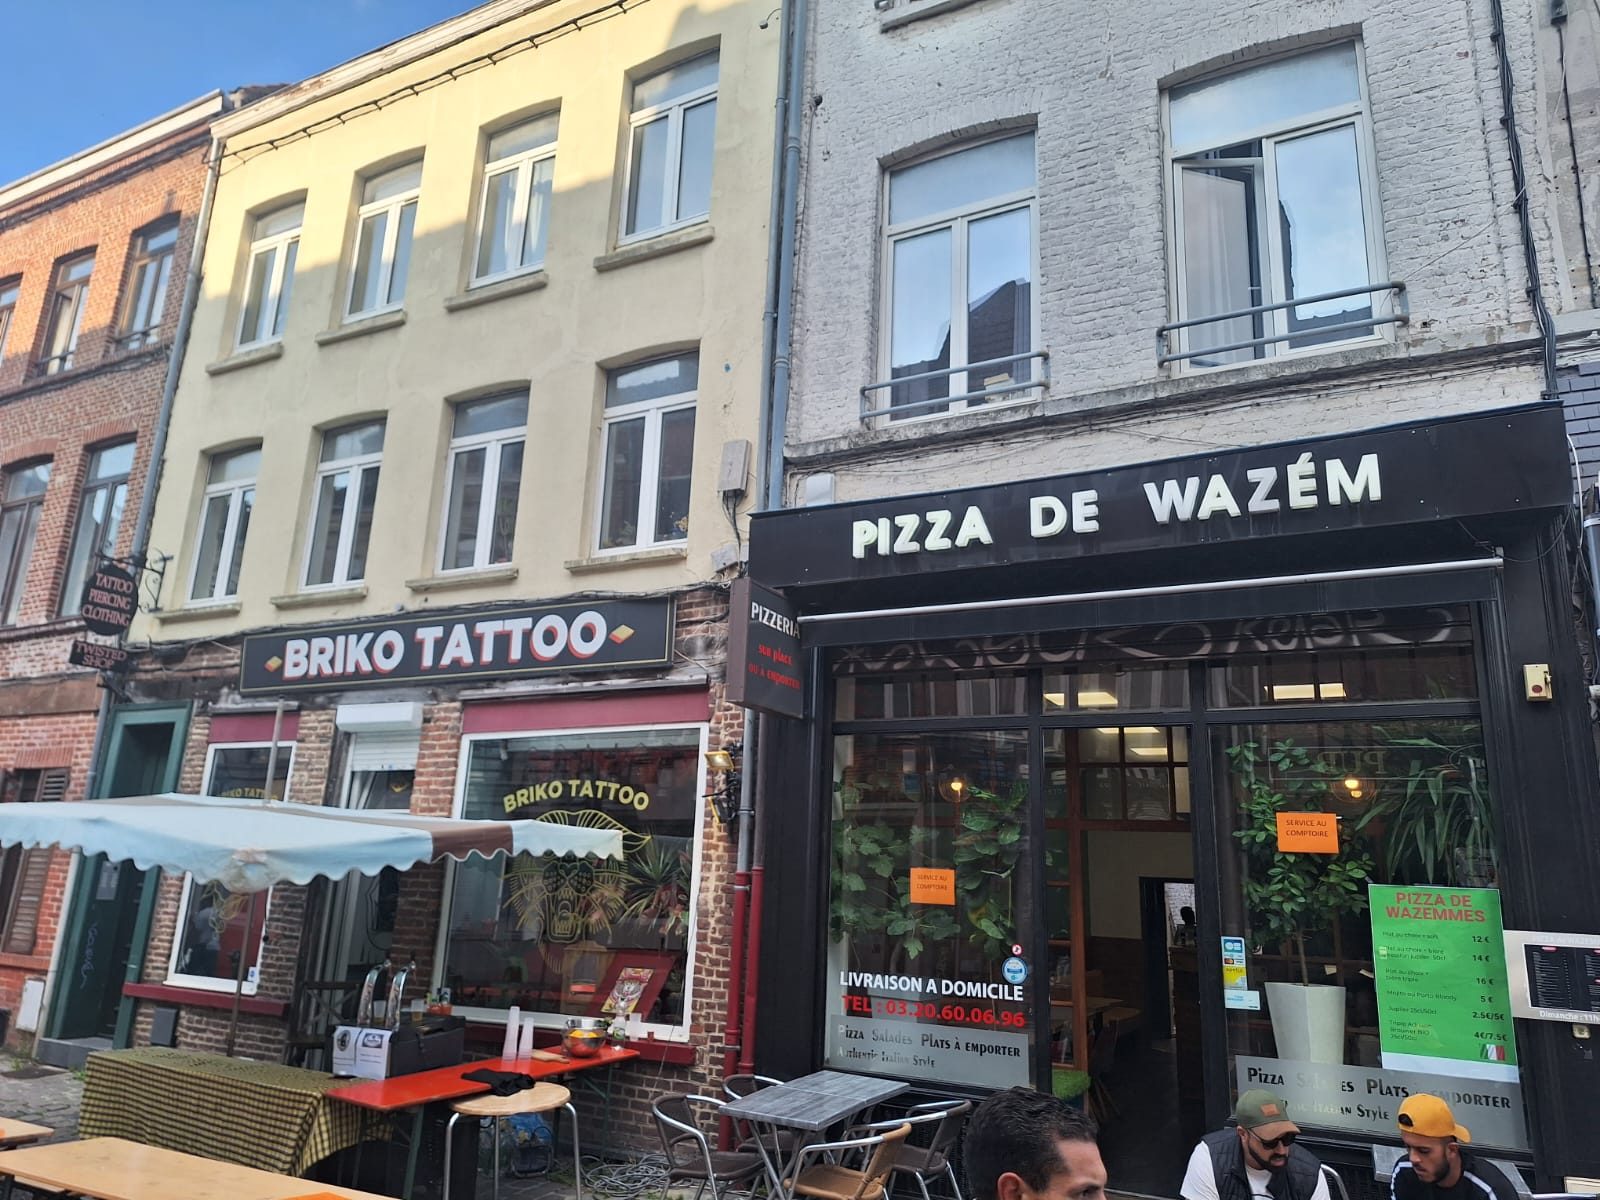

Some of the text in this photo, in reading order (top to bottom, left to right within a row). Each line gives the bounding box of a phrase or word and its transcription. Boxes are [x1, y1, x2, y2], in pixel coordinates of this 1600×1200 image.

[852, 451, 1382, 559] PIZZA DE WAZÉM
[96, 573, 133, 592] TATTOO
[89, 588, 130, 610] PIERCING
[82, 604, 129, 626] CLOTHING
[751, 601, 800, 639] PIZZERIA
[76, 642, 127, 661] TWISTED
[282, 610, 608, 681] BRIKO TATTOO
[83, 655, 114, 669] SHOP
[504, 779, 649, 813] BRIKO TATTOO
[1286, 819, 1315, 827] SERVICE
[1396, 892, 1473, 908] PIZZA DE
[1386, 906, 1486, 923] WAZEMMES
[1472, 935, 1482, 943] 12
[1472, 954, 1490, 963] 14 €
[839, 971, 1024, 1002] LIVRAISON A DOMICILE
[1476, 977, 1494, 986] 16 €
[1480, 995, 1486, 1003] 5
[842, 995, 872, 1013] TEL
[885, 999, 1026, 1028] 03.20.60.06.96
[1472, 1011, 1505, 1021] 2.5€/5€
[1473, 1031, 1508, 1042] 4€/7.5€
